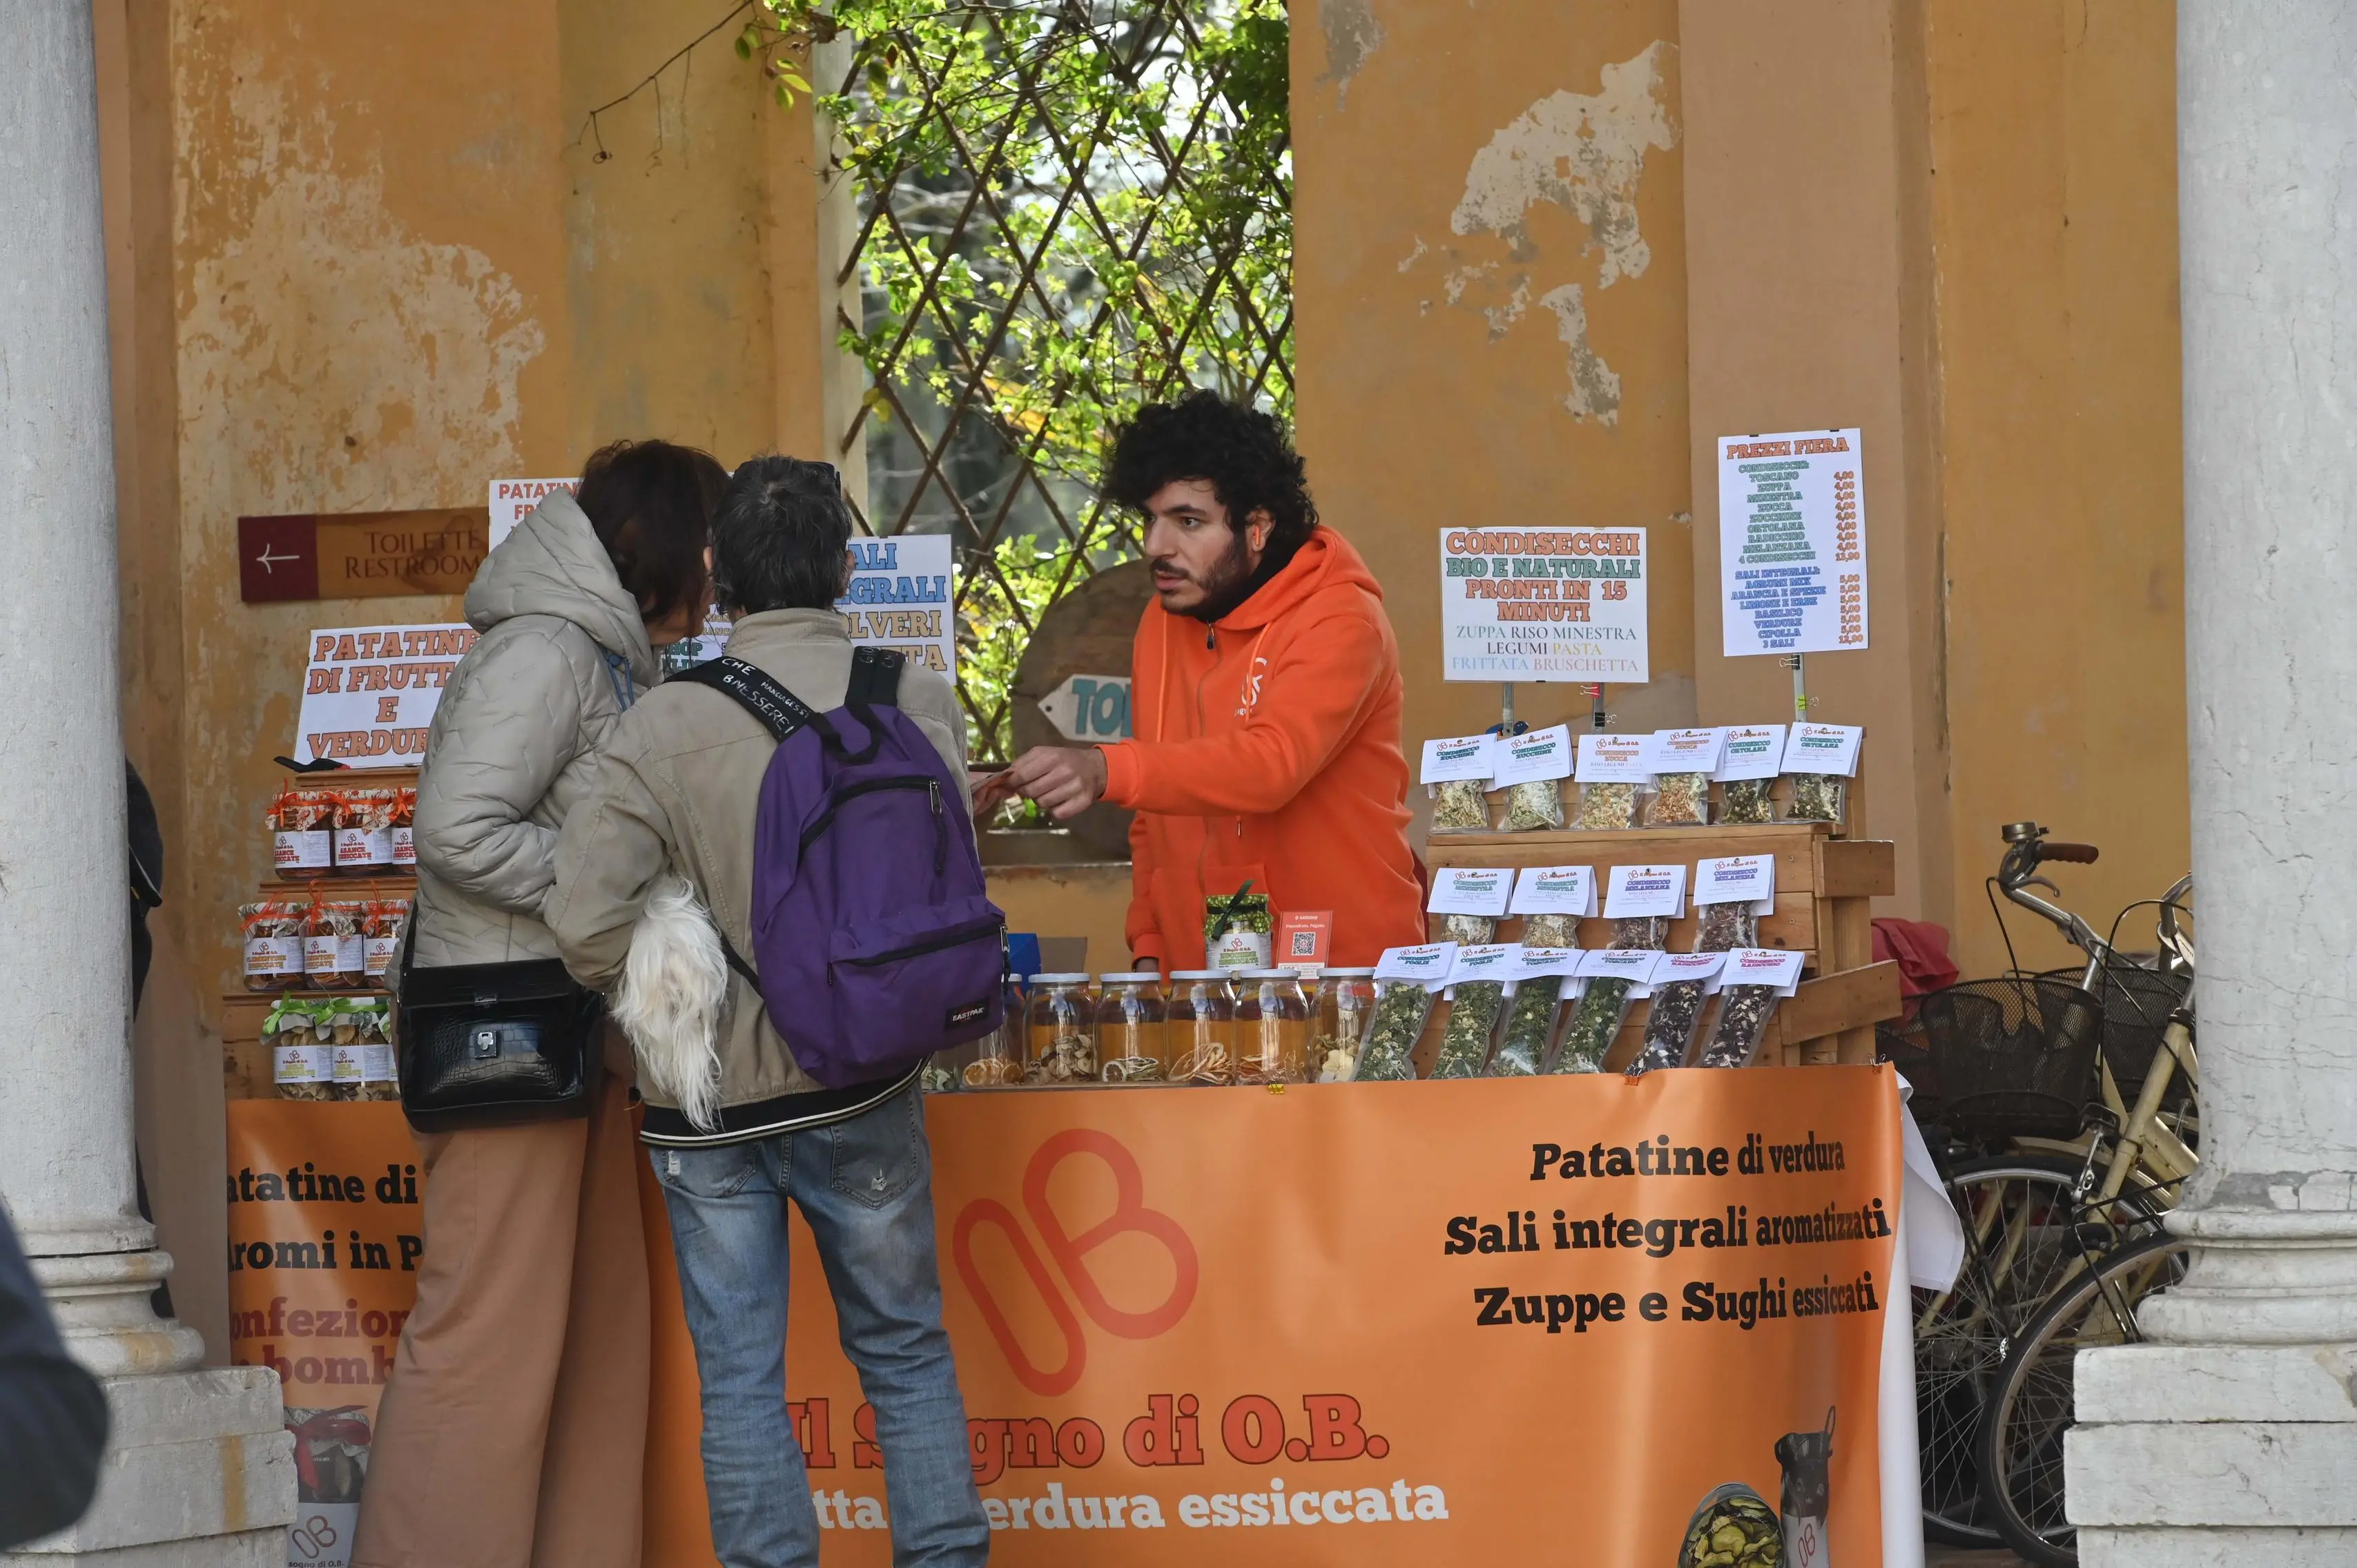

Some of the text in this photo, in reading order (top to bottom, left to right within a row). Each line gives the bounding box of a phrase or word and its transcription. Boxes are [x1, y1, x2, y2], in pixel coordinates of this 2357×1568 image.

[1727, 437, 1850, 459] PREZZI FIERA
[1749, 471, 1799, 483] TOSCANO
[499, 482, 579, 499] PATATN
[1758, 482, 1792, 492] ZUPPA
[1747, 492, 1803, 503] MINESTRA
[1758, 502, 1793, 512] ZUCCA
[1749, 512, 1802, 523] ZUCCHINE
[1747, 522, 1805, 533] ORTOLANA
[364, 529, 481, 554] TOILETTE
[1446, 532, 1640, 556] CONDISECCHI
[1748, 532, 1805, 543] RADICCHIO
[1743, 541, 1811, 554] MELANZANA
[1738, 556, 1745, 564] 4
[1747, 551, 1816, 563] CONDISECCHI
[1446, 558, 1640, 578] BIO E NATURALI
[1735, 570, 1760, 580] SALI
[1466, 579, 1627, 600] PRONTI IN 15
[1745, 579, 1787, 589] AGRUMI
[1789, 577, 1811, 586] MIX
[1731, 589, 1780, 600] ARANCIA
[1781, 588, 1788, 597] E
[1789, 586, 1826, 597] SPEZIE
[1740, 599, 1781, 610] LIMONE
[1782, 599, 1789, 607] E
[1791, 597, 1817, 606] ERBE
[1497, 601, 1590, 621] MINUTI
[1755, 608, 1803, 619] BASILICO
[1754, 618, 1802, 629] VERDURE
[1457, 626, 1636, 640] ZUPPA RISO MINESTRA
[1758, 628, 1801, 639] CIPOLLA
[313, 628, 481, 661] PATATINE
[1487, 642, 1602, 655] LEGUMI PASTA
[1770, 639, 1795, 648] SALI
[722, 658, 757, 676] CHE
[1453, 657, 1638, 672] FRITTATA BRUSCHETTA
[307, 668, 342, 695] DI
[376, 697, 399, 722] E
[953, 1007, 983, 1021] EASTPAK
[1530, 1131, 1845, 1180] Patatine di verdura
[376, 1164, 418, 1203] di
[1444, 1198, 1891, 1258] Sali integrali aromatizzati
[350, 1230, 391, 1269] in
[1474, 1270, 1879, 1333] Zuppe e Sughi essiccati
[853, 1402, 1105, 1486] Sgno
[1123, 1393, 1204, 1467] di
[1221, 1393, 1390, 1464] O.B.
[1178, 1478, 1448, 1528] essiccata
